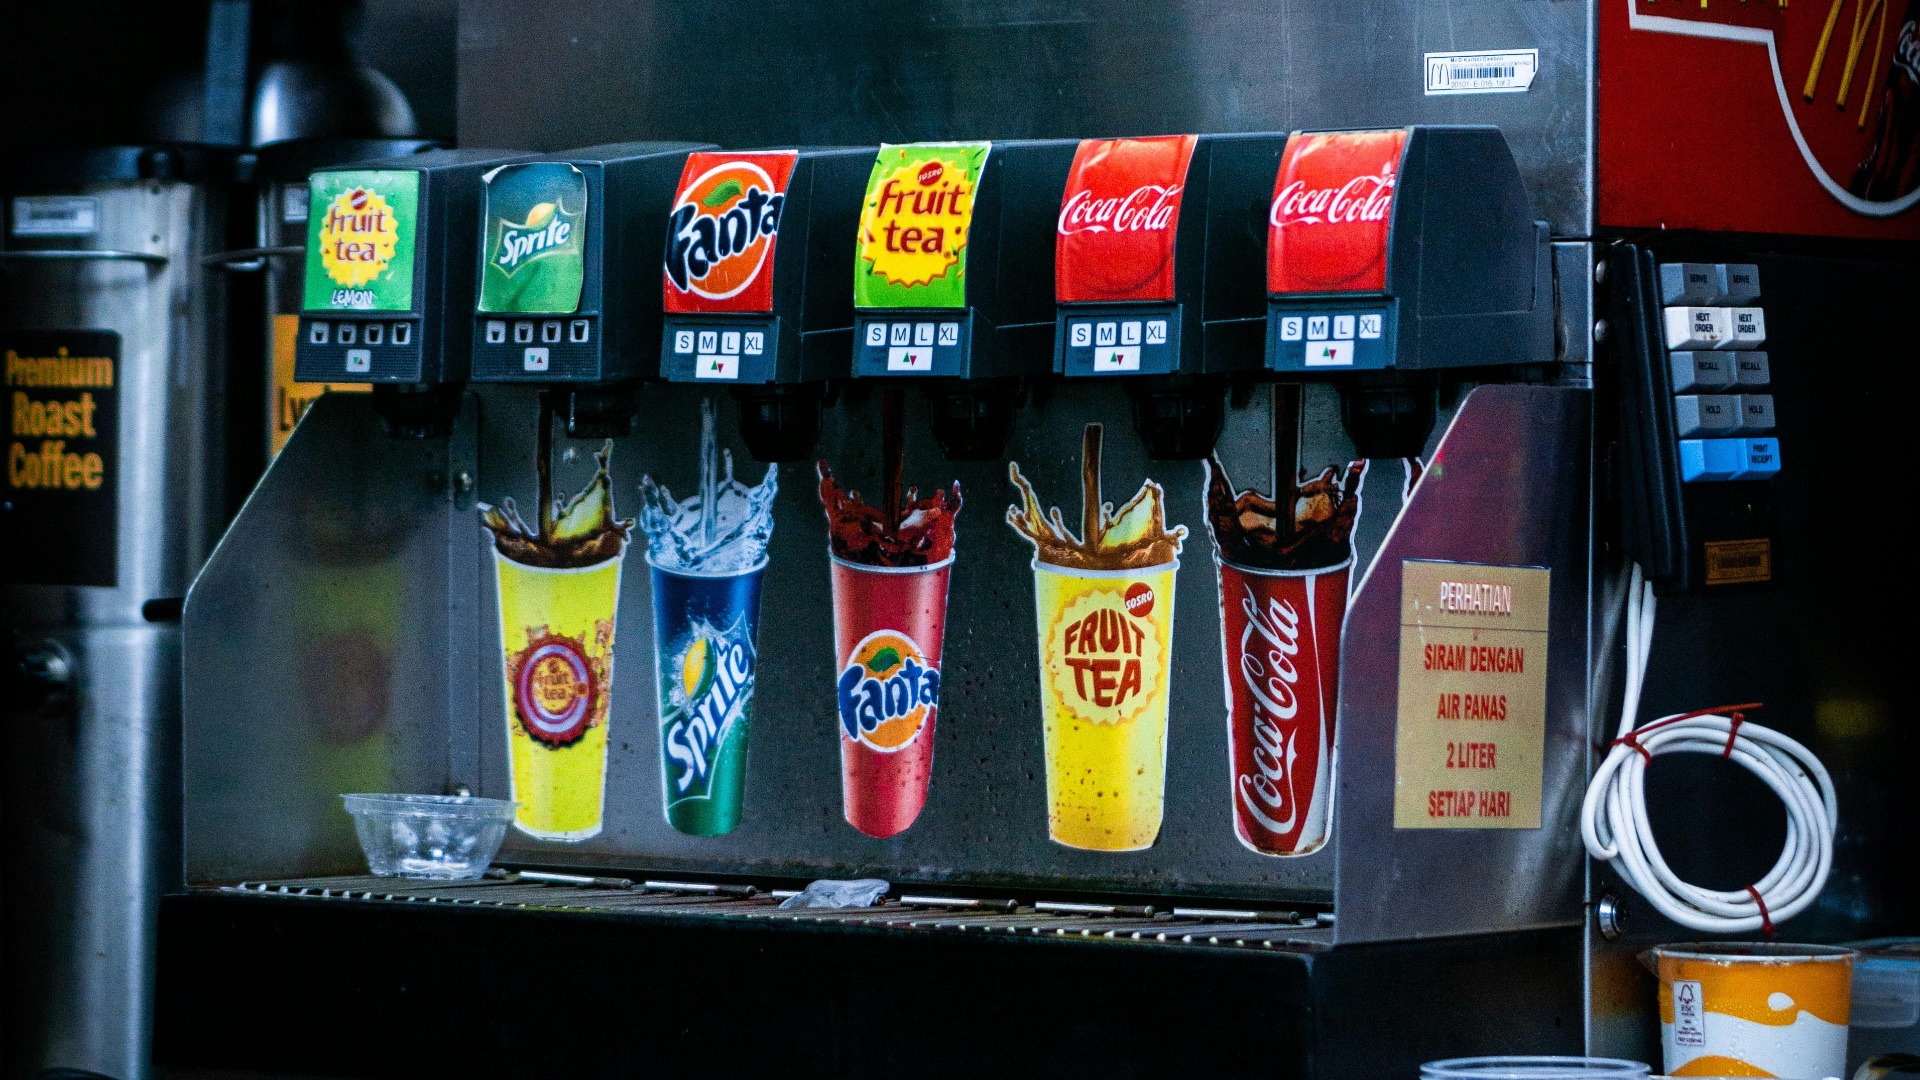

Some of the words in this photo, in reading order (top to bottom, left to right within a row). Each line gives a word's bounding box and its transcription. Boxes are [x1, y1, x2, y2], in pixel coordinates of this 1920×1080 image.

[877, 180, 966, 218] fruit
[1058, 183, 1182, 236] Coca-Cola
[1270, 174, 1396, 227] Coca-Cola
[328, 205, 387, 235] fruit
[334, 237, 376, 262] tea
[499, 209, 570, 267] Sprite
[664, 186, 785, 292] Fanta
[884, 225, 945, 254] tea
[1689, 274, 1708, 284] SERVE
[1732, 275, 1750, 284] SERVE
[331, 289, 374, 305] LEMON
[1287, 321, 1298, 336] S
[1312, 320, 1324, 335] M
[1339, 319, 1347, 334] L
[1362, 318, 1381, 333] XL
[1694, 323, 1713, 333] ORDER
[1695, 313, 1710, 322] NEXT
[1737, 324, 1756, 333] ORDER
[1738, 313, 1752, 322] NEXT
[680, 335, 690, 349] S
[702, 336, 714, 349] M
[726, 336, 734, 350] L
[745, 336, 763, 351] XL
[872, 327, 882, 341] S
[894, 327, 906, 341] M
[920, 327, 928, 341] L
[939, 327, 957, 341] XL
[1076, 328, 1086, 342] S
[1100, 327, 1112, 341] M
[1127, 326, 1135, 340] L
[1147, 325, 1166, 339] XL
[6, 346, 114, 388] Premium
[1698, 362, 1719, 371] RECALL
[1741, 362, 1762, 371] RECALL
[13, 391, 97, 437] Roast
[1705, 405, 1721, 414] HOLD
[1749, 405, 1764, 414] HOLD
[1751, 454, 1773, 464] RECEIPT
[1752, 444, 1768, 453] PRINT
[9, 440, 104, 489] Coffee
[1125, 590, 1154, 611] SOSRO
[1439, 581, 1511, 613] PERHATIAN
[1064, 607, 1146, 656] FRUIT
[1424, 643, 1466, 672] SIRAM
[1469, 646, 1524, 674] DENGAN
[1064, 657, 1142, 708] TEA
[838, 657, 941, 741] Fanta
[1238, 581, 1300, 834] Coca-Cola
[1437, 693, 1461, 721] AIR
[1464, 693, 1507, 721] PANAS
[667, 637, 749, 793] Sprite
[1446, 741, 1455, 769] 2
[1458, 742, 1496, 769] LITER
[1428, 790, 1475, 818] SETIAP
[1478, 791, 1511, 818] HARI
